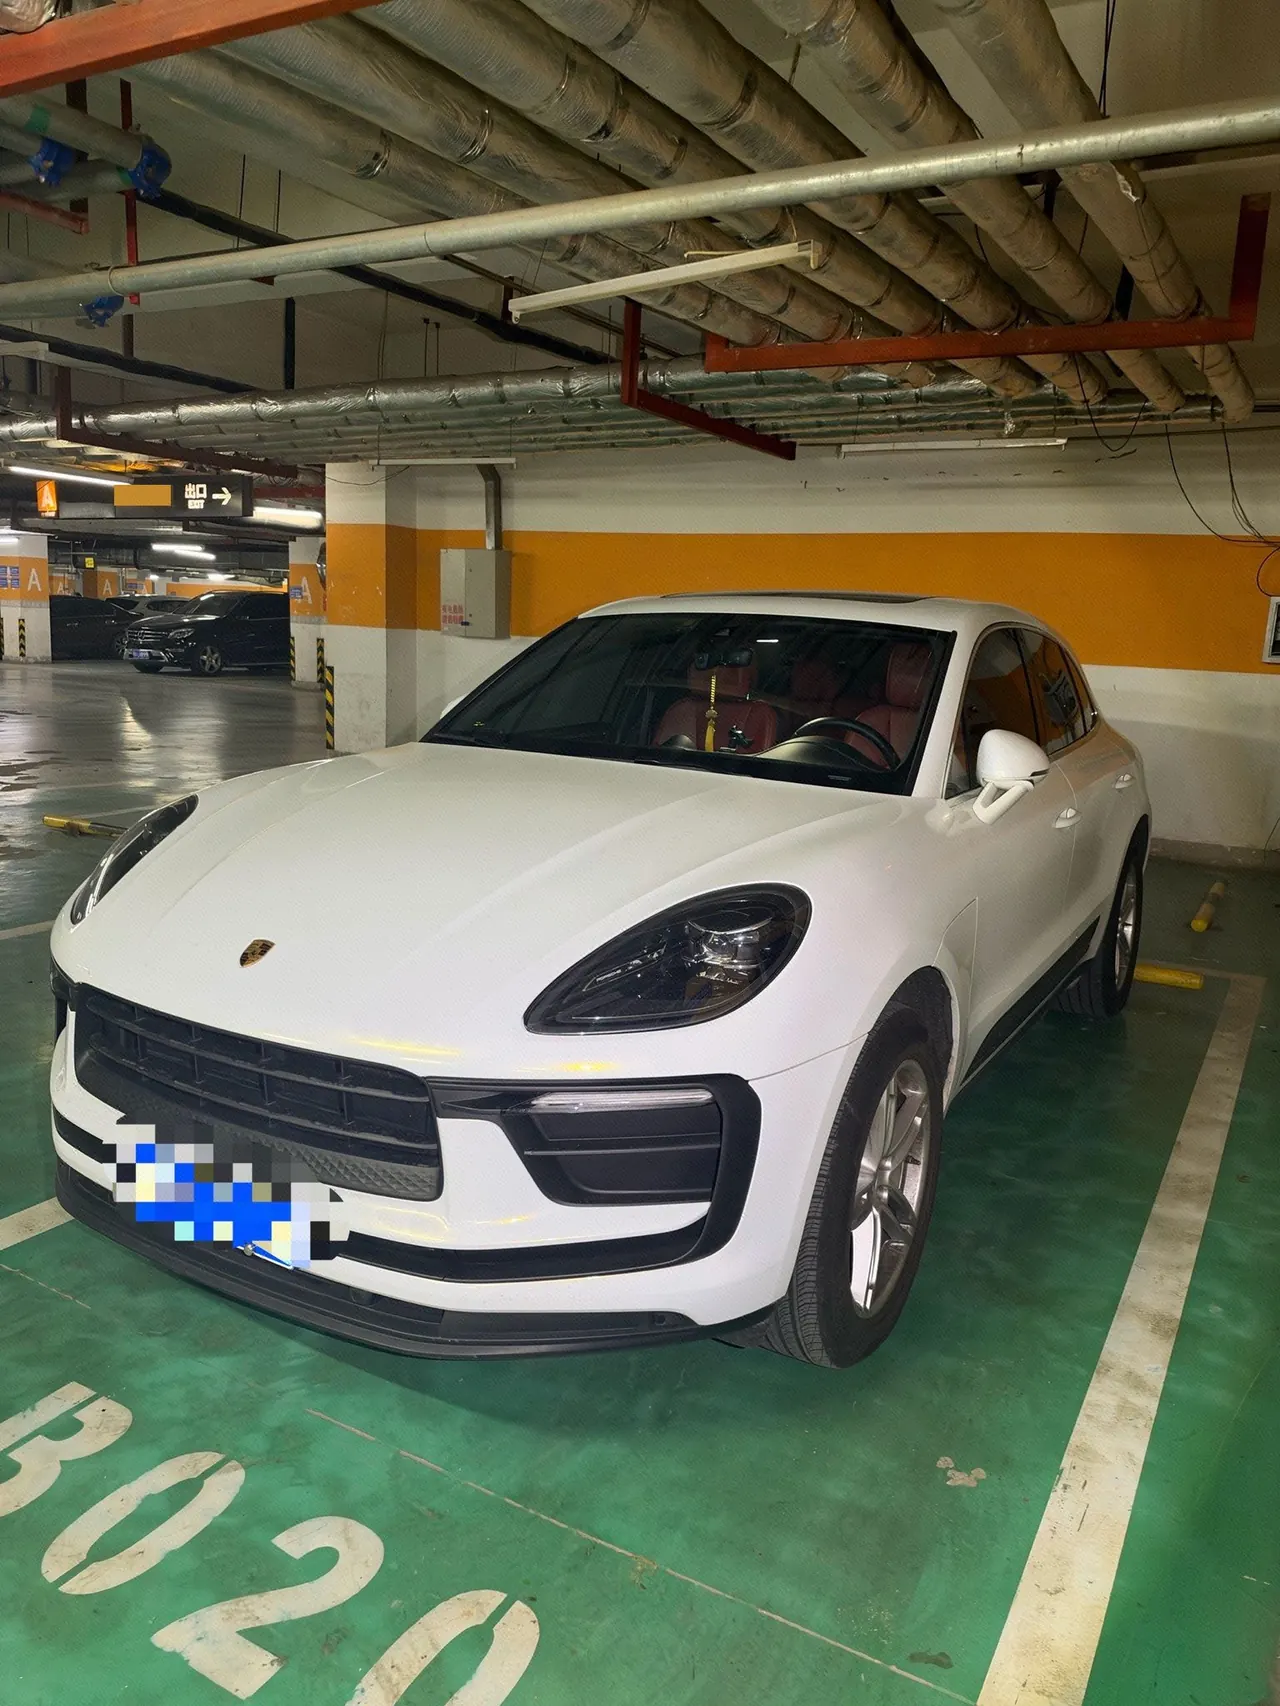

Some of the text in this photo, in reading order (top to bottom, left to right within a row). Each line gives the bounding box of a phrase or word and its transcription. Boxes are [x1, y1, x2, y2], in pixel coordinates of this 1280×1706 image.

[41, 485, 55, 508] A
[185, 483, 207, 499] 出口
[27, 568, 42, 592] A
[102, 579, 113, 596] A
[297, 576, 312, 604] A
